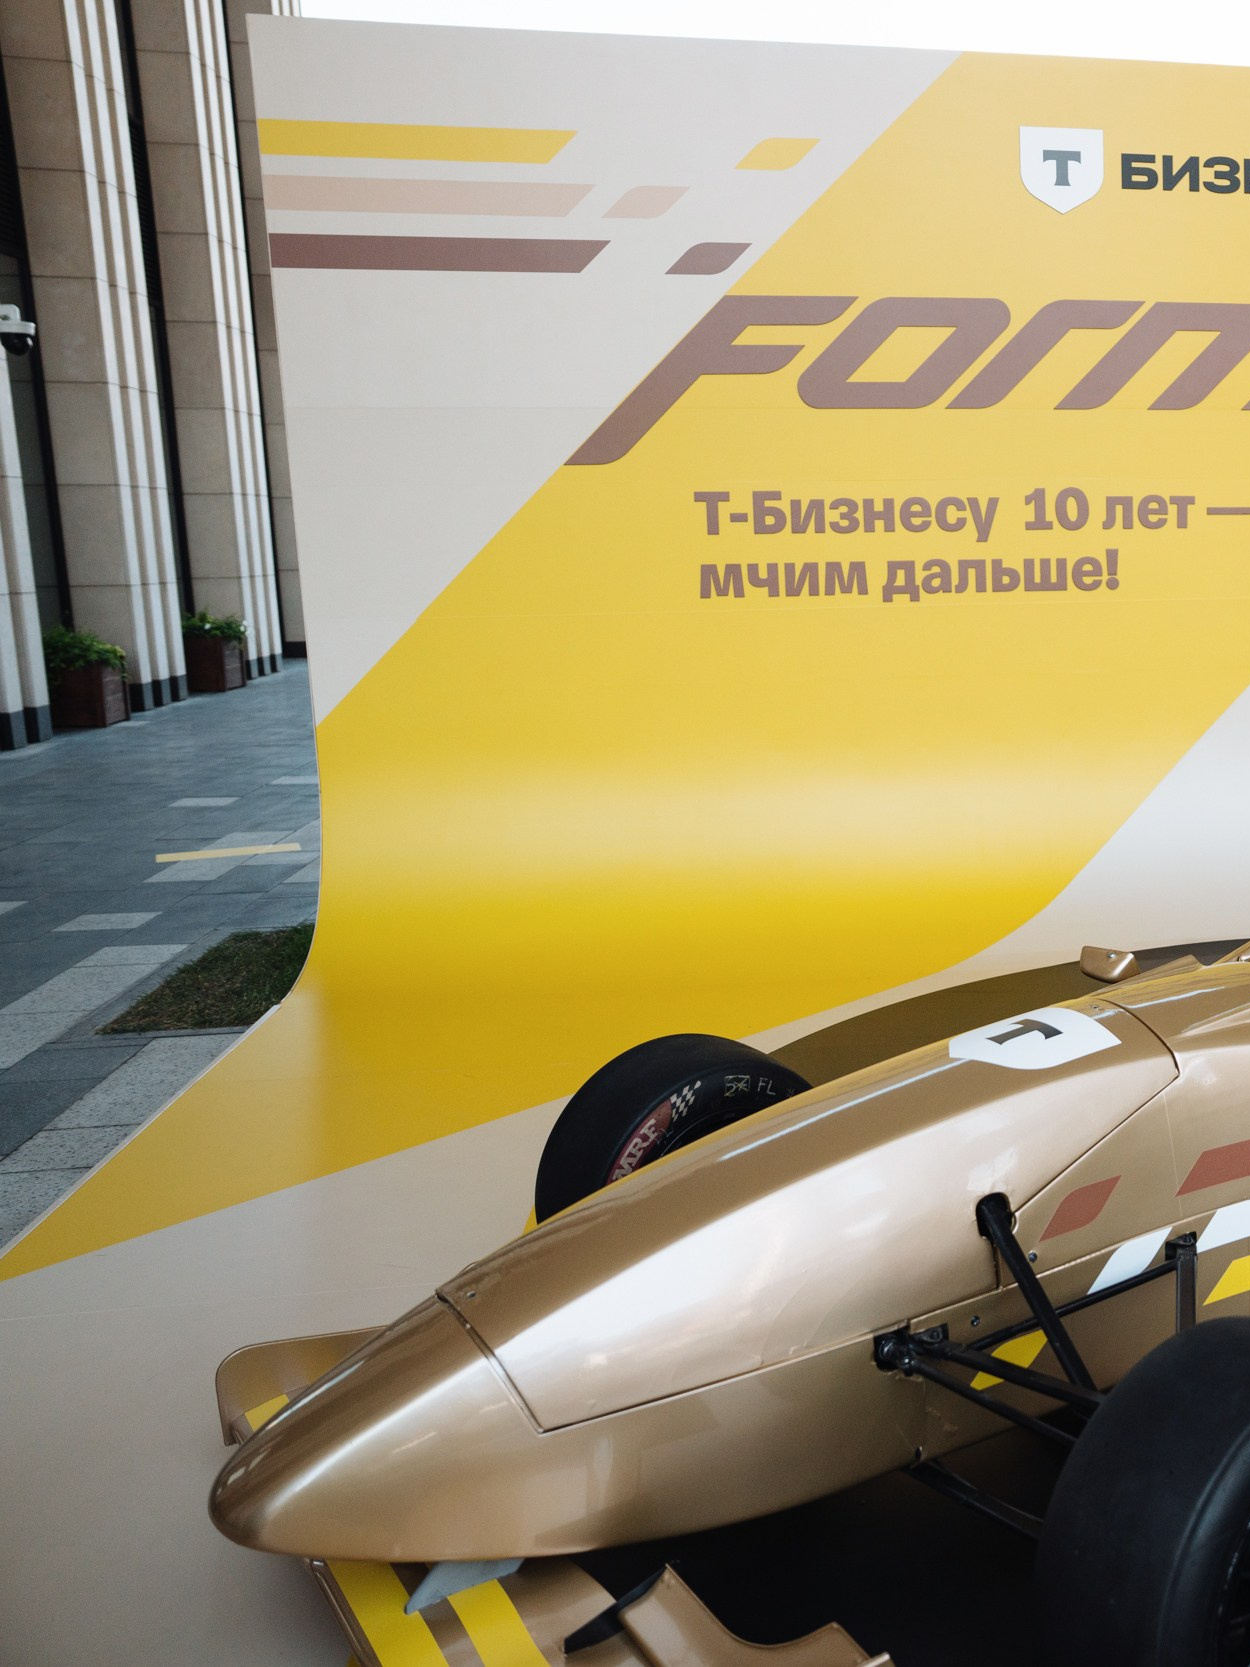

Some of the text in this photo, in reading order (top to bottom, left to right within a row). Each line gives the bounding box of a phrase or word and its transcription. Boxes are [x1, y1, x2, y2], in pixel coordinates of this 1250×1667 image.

[1042, 149, 1082, 187] Т
[693, 490, 999, 543] Т-Бизнесу
[1025, 486, 1090, 531] 10
[1102, 494, 1197, 530] лет
[699, 548, 1120, 603] мчим дальше!
